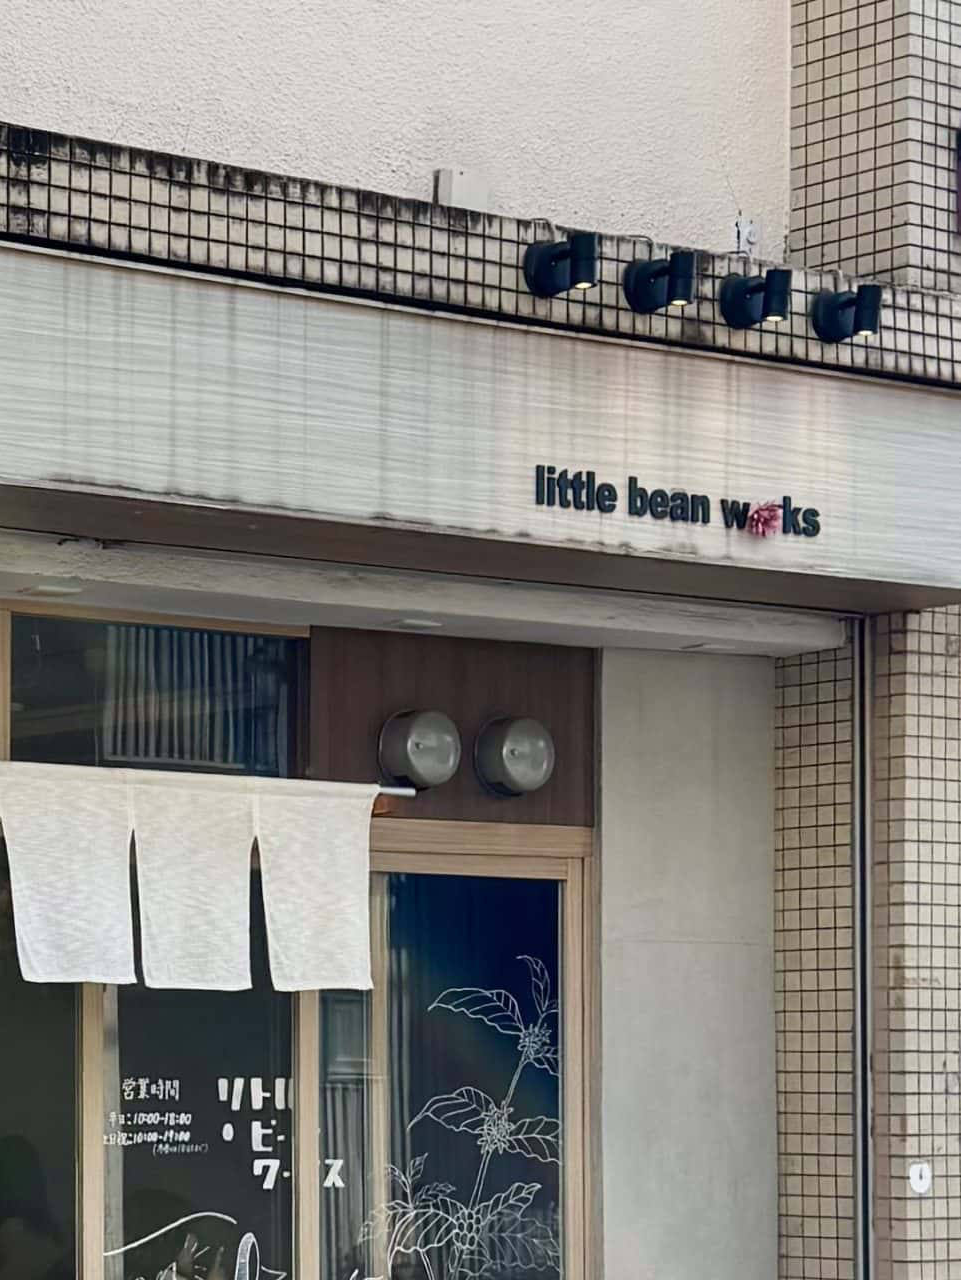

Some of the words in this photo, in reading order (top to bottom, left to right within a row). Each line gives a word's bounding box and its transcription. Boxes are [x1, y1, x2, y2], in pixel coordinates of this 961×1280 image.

[535, 464, 618, 513] little
[627, 476, 711, 525] bean
[122, 1078, 180, 1101] 営業時間
